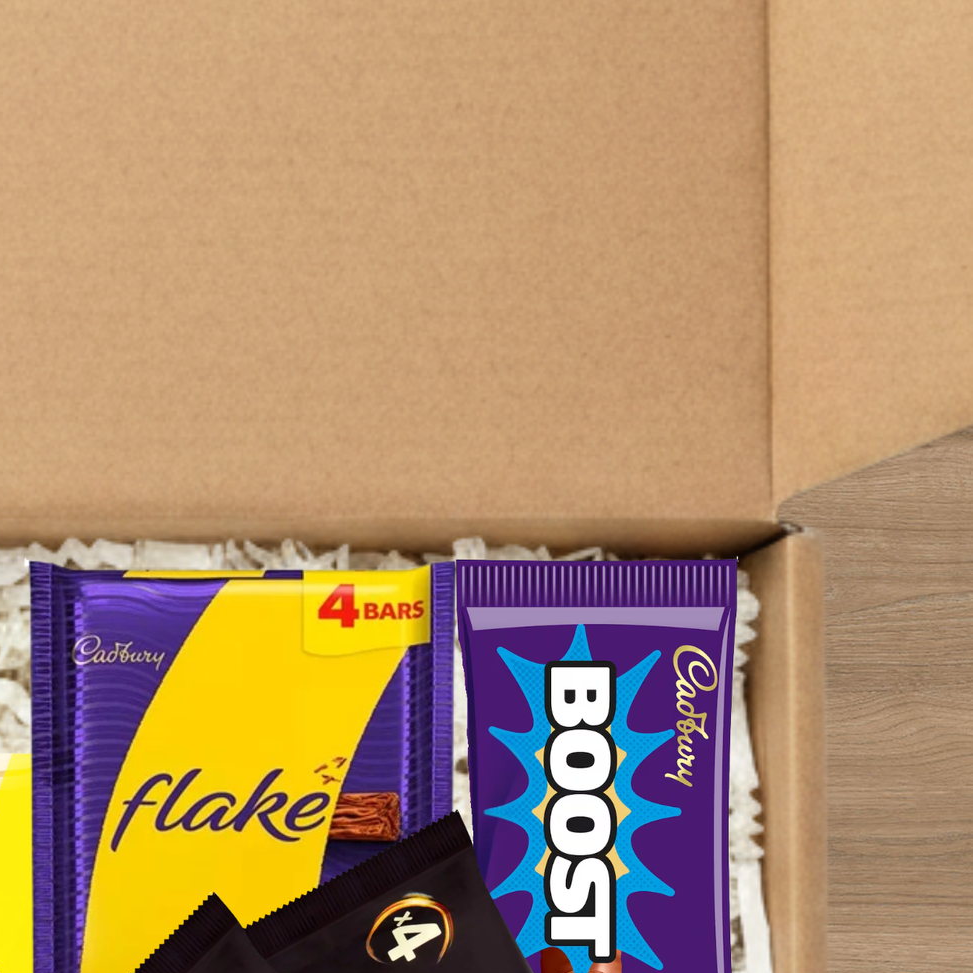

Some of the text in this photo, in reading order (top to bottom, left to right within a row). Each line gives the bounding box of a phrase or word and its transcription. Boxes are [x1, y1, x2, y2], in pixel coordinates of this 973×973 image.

[318, 584, 425, 628] 4 BARS
[72, 635, 166, 671] Cadbury
[665, 644, 719, 788] Cadbury
[111, 768, 331, 852] flake
[545, 662, 616, 962] BOOST
[394, 911, 441, 962] x4
